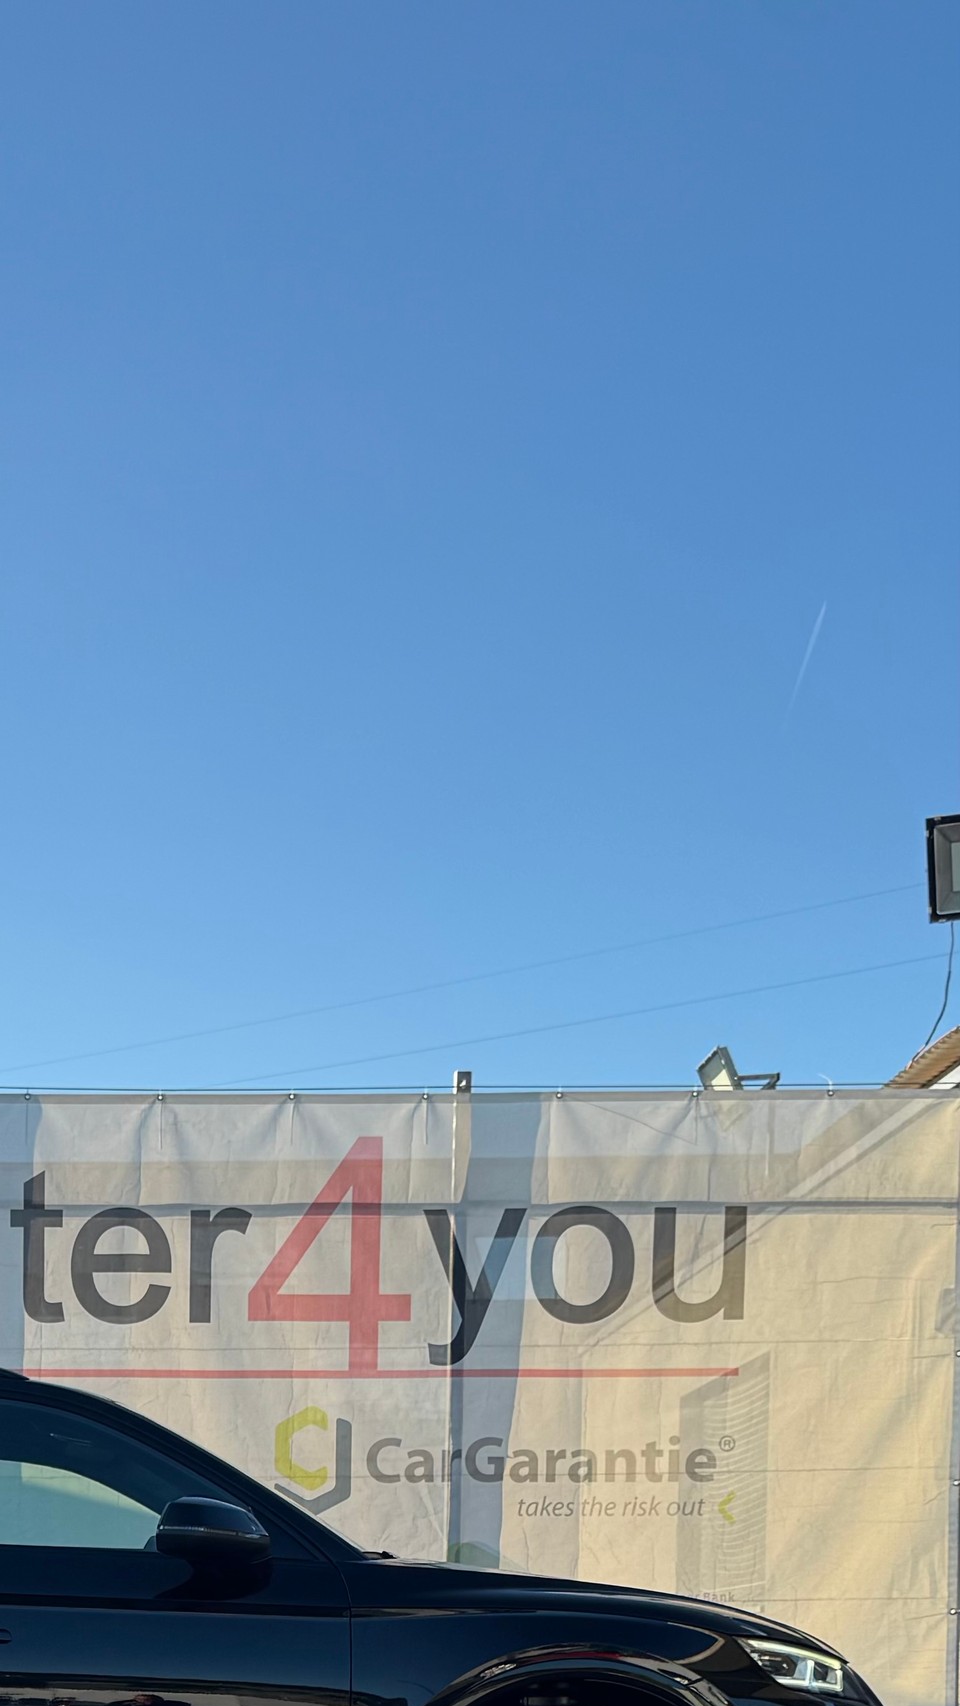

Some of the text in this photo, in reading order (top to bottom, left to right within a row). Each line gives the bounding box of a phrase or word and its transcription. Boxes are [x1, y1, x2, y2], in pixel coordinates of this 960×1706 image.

[517, 1496, 706, 1517] takes the risk out
[703, 1591, 735, 1602] Bank
